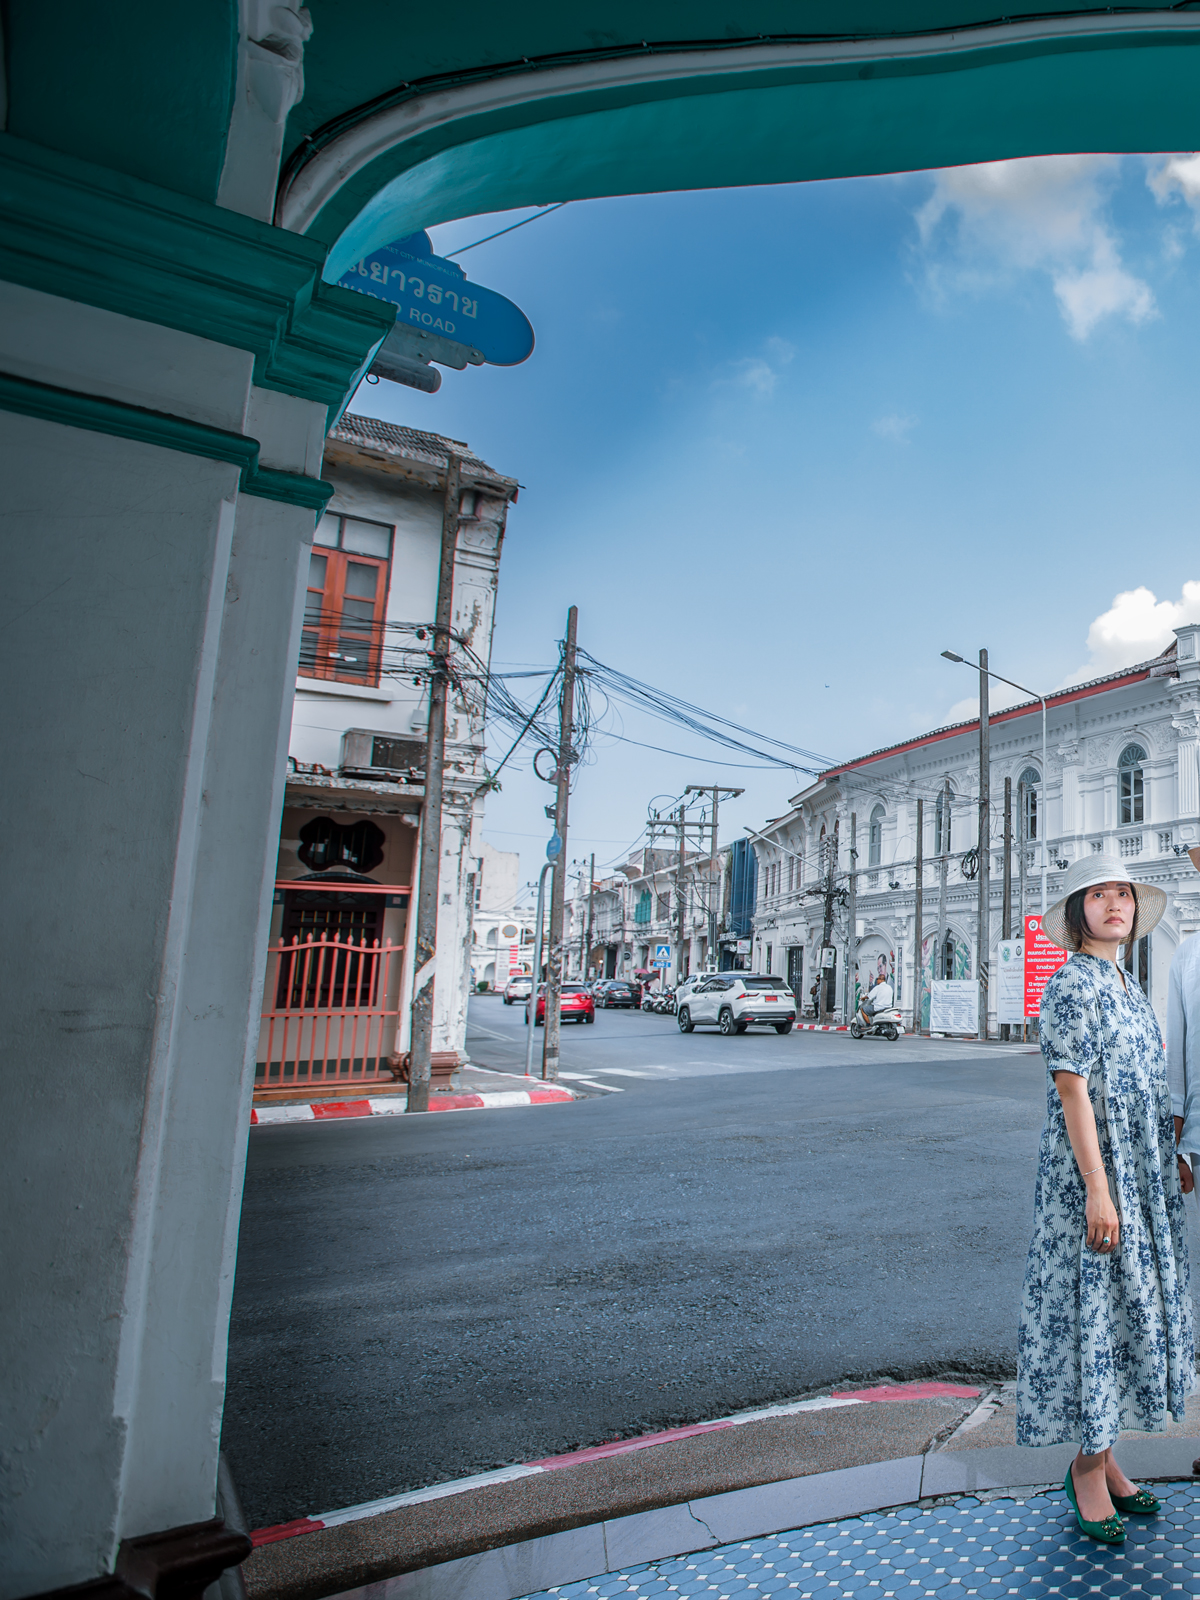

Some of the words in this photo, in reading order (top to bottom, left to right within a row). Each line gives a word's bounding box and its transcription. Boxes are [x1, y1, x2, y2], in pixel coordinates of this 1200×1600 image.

[400, 250, 415, 261] CITY
[416, 257, 460, 279] MUNICIPALITY
[348, 259, 479, 319] เยาวราช
[409, 307, 456, 334] ROAD
